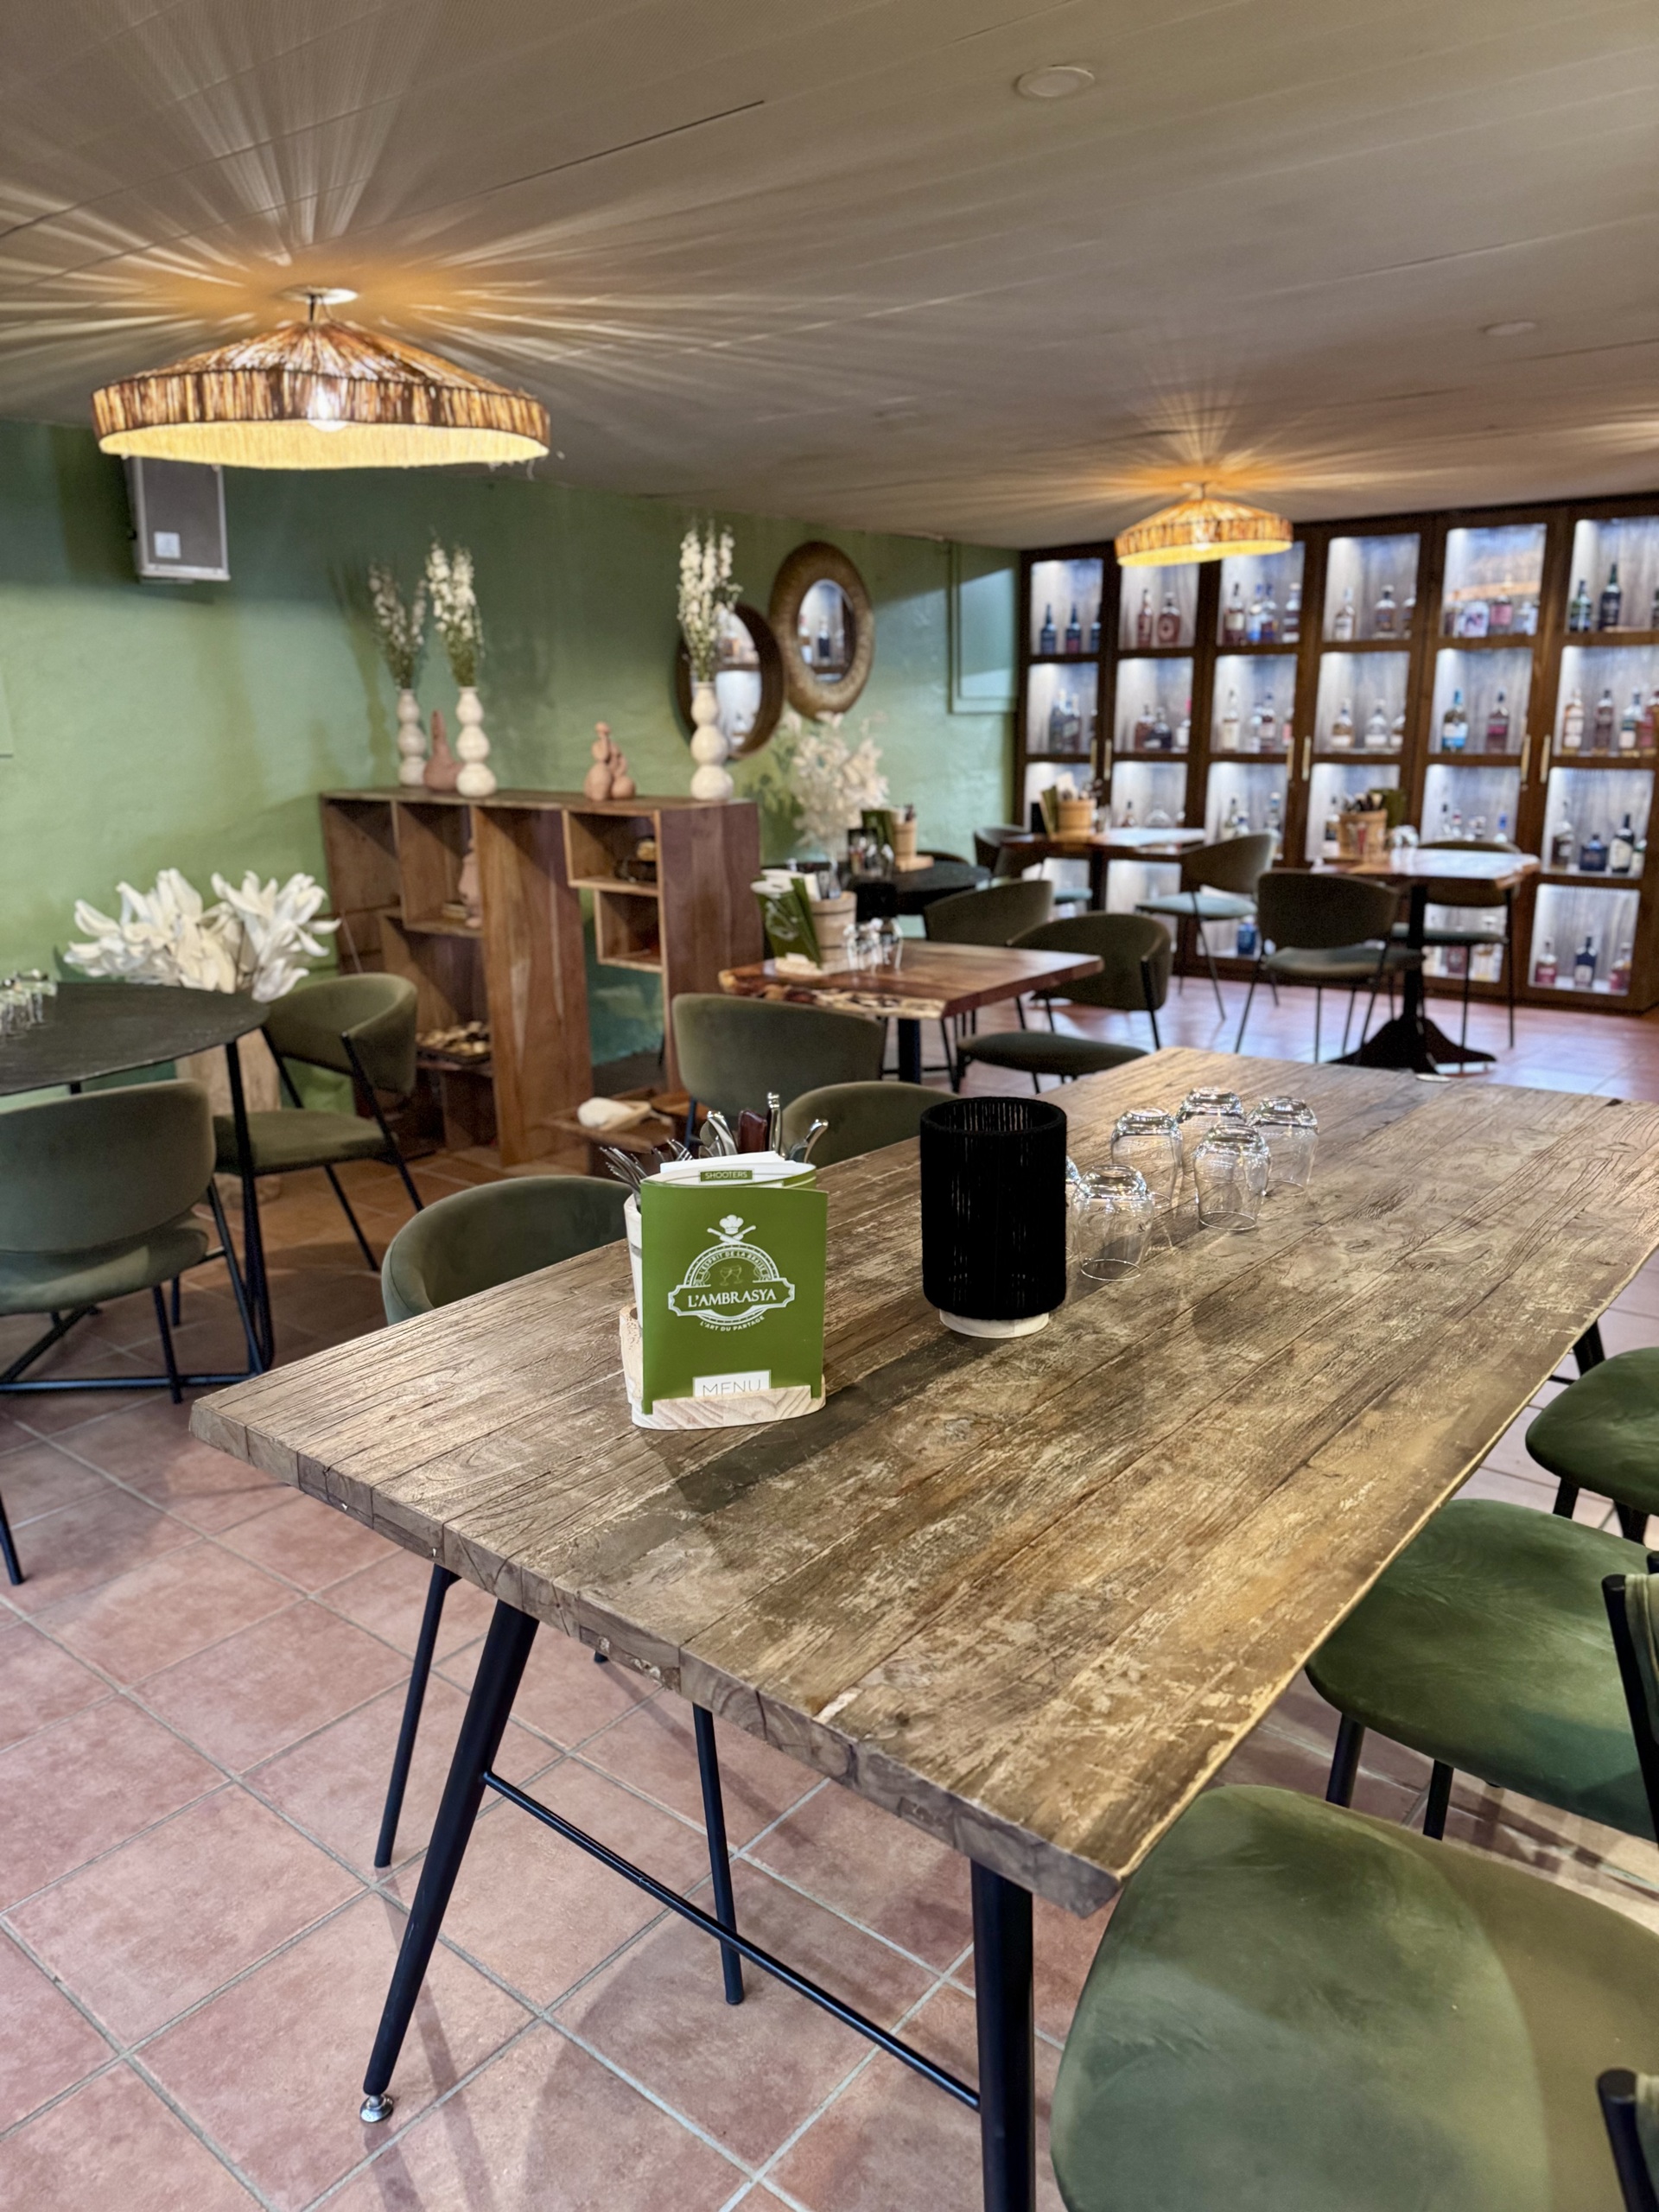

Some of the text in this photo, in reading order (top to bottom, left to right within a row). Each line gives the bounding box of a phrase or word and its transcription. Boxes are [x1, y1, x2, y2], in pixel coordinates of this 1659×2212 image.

[704, 1171, 748, 1179] SHOOTERS
[688, 1288, 777, 1307] L'AMBRASYA
[700, 1320, 719, 1331] L'ART
[733, 1315, 765, 1331] PARTAGE
[702, 1379, 761, 1396] MENU
